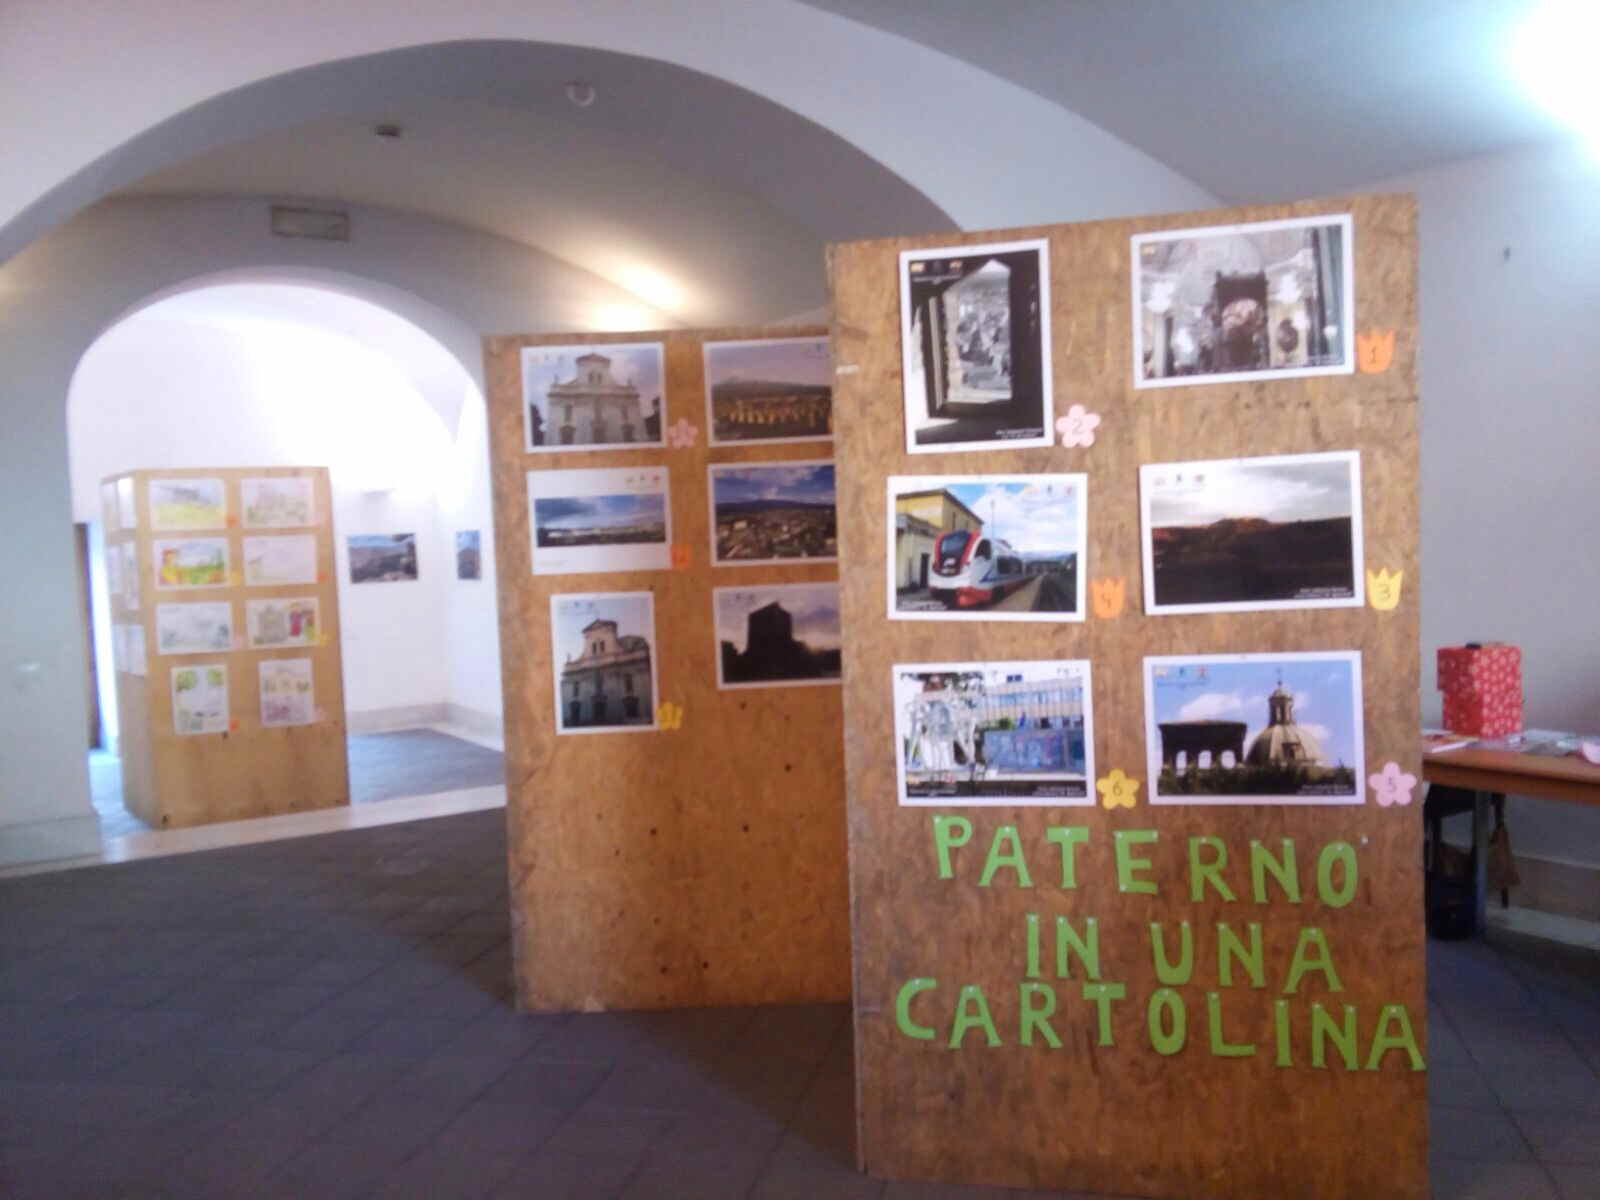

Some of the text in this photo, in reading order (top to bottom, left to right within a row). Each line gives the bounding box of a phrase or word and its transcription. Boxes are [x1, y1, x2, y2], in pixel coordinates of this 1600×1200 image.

[1072, 418, 1084, 434] 2
[1378, 583, 1391, 599] 3
[1112, 780, 1122, 796] 6
[1025, 913, 1344, 993] IN UNA
[896, 977, 1426, 1072] CARTOLINA
